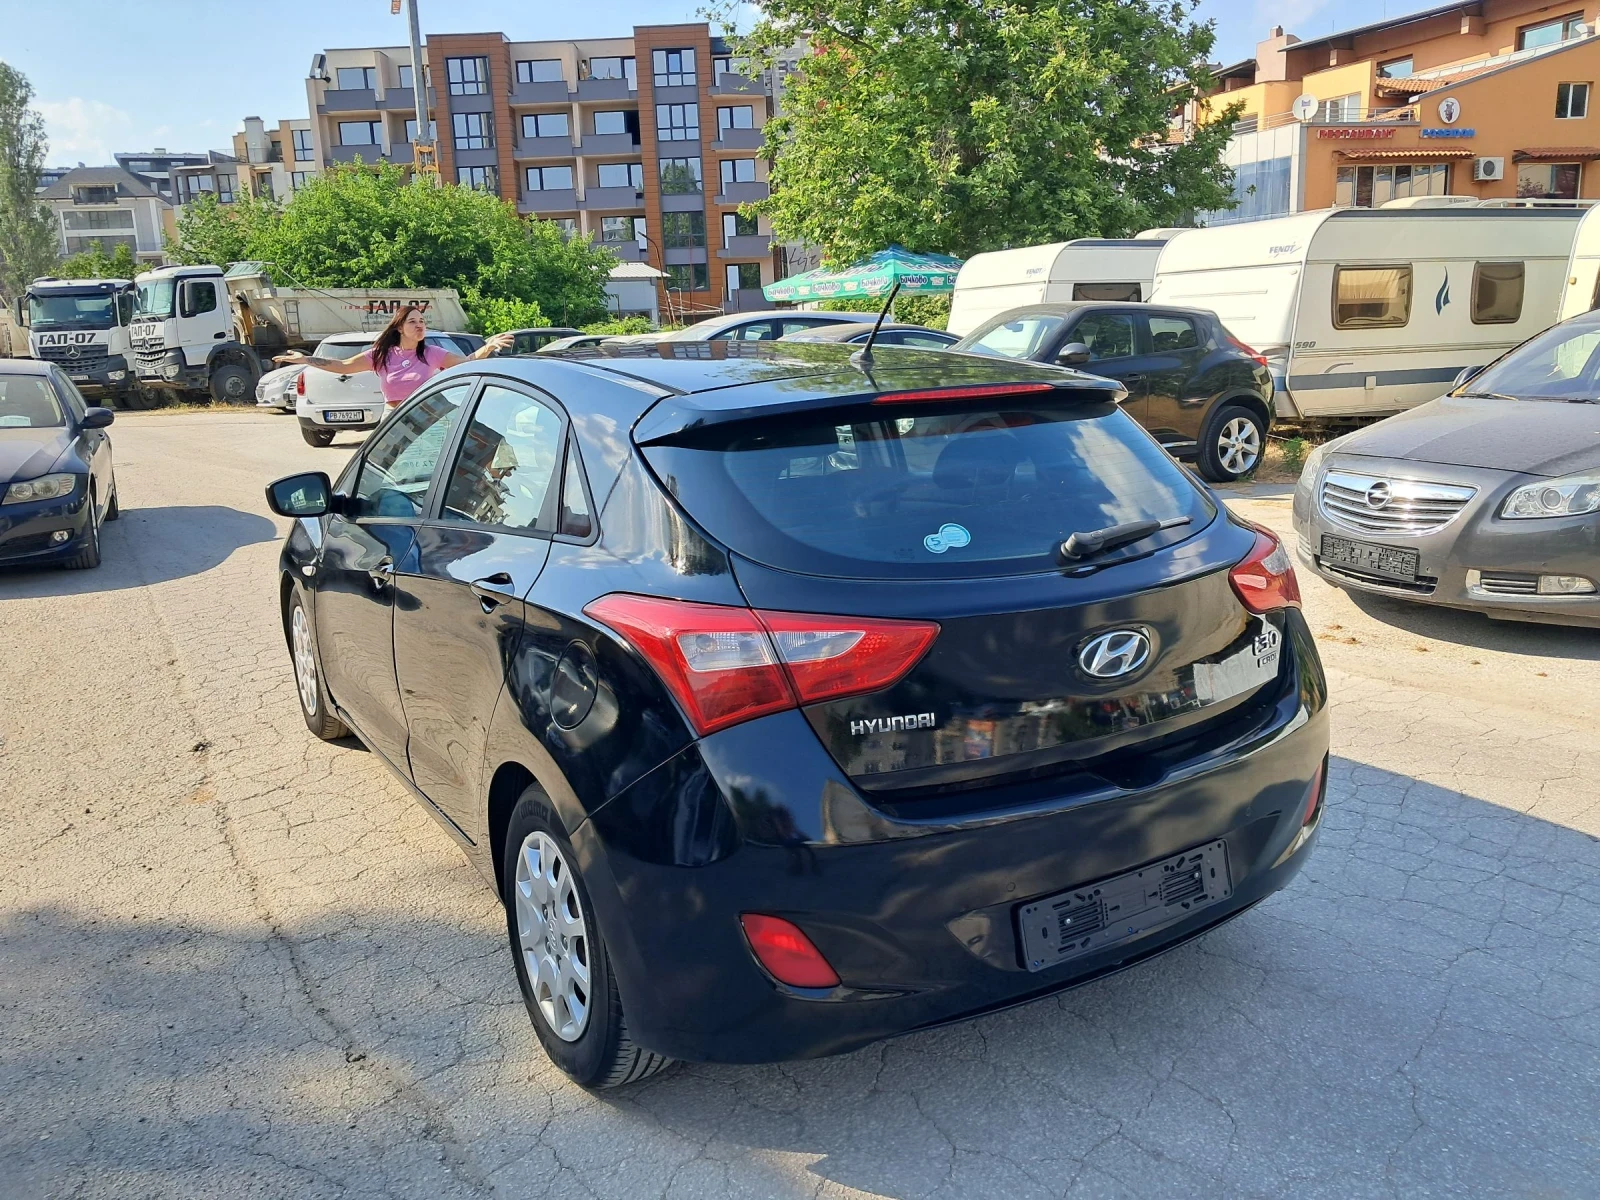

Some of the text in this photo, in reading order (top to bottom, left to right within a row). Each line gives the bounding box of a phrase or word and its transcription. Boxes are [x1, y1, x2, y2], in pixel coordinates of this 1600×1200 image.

[1317, 129, 1396, 139] RESTAURANT
[1420, 128, 1476, 138] POSEIDON
[1269, 244, 1297, 254] FENDT
[899, 274, 928, 285] Бачково
[767, 286, 795, 296] Бачково
[813, 282, 841, 292] Бачково
[368, 300, 430, 314] ГАП7
[131, 324, 156, 337] ГАП-07
[40, 333, 96, 345] ГАП-07
[1295, 341, 1316, 349] 590
[1252, 630, 1279, 657] i30
[850, 712, 936, 736] HYUNDAI
